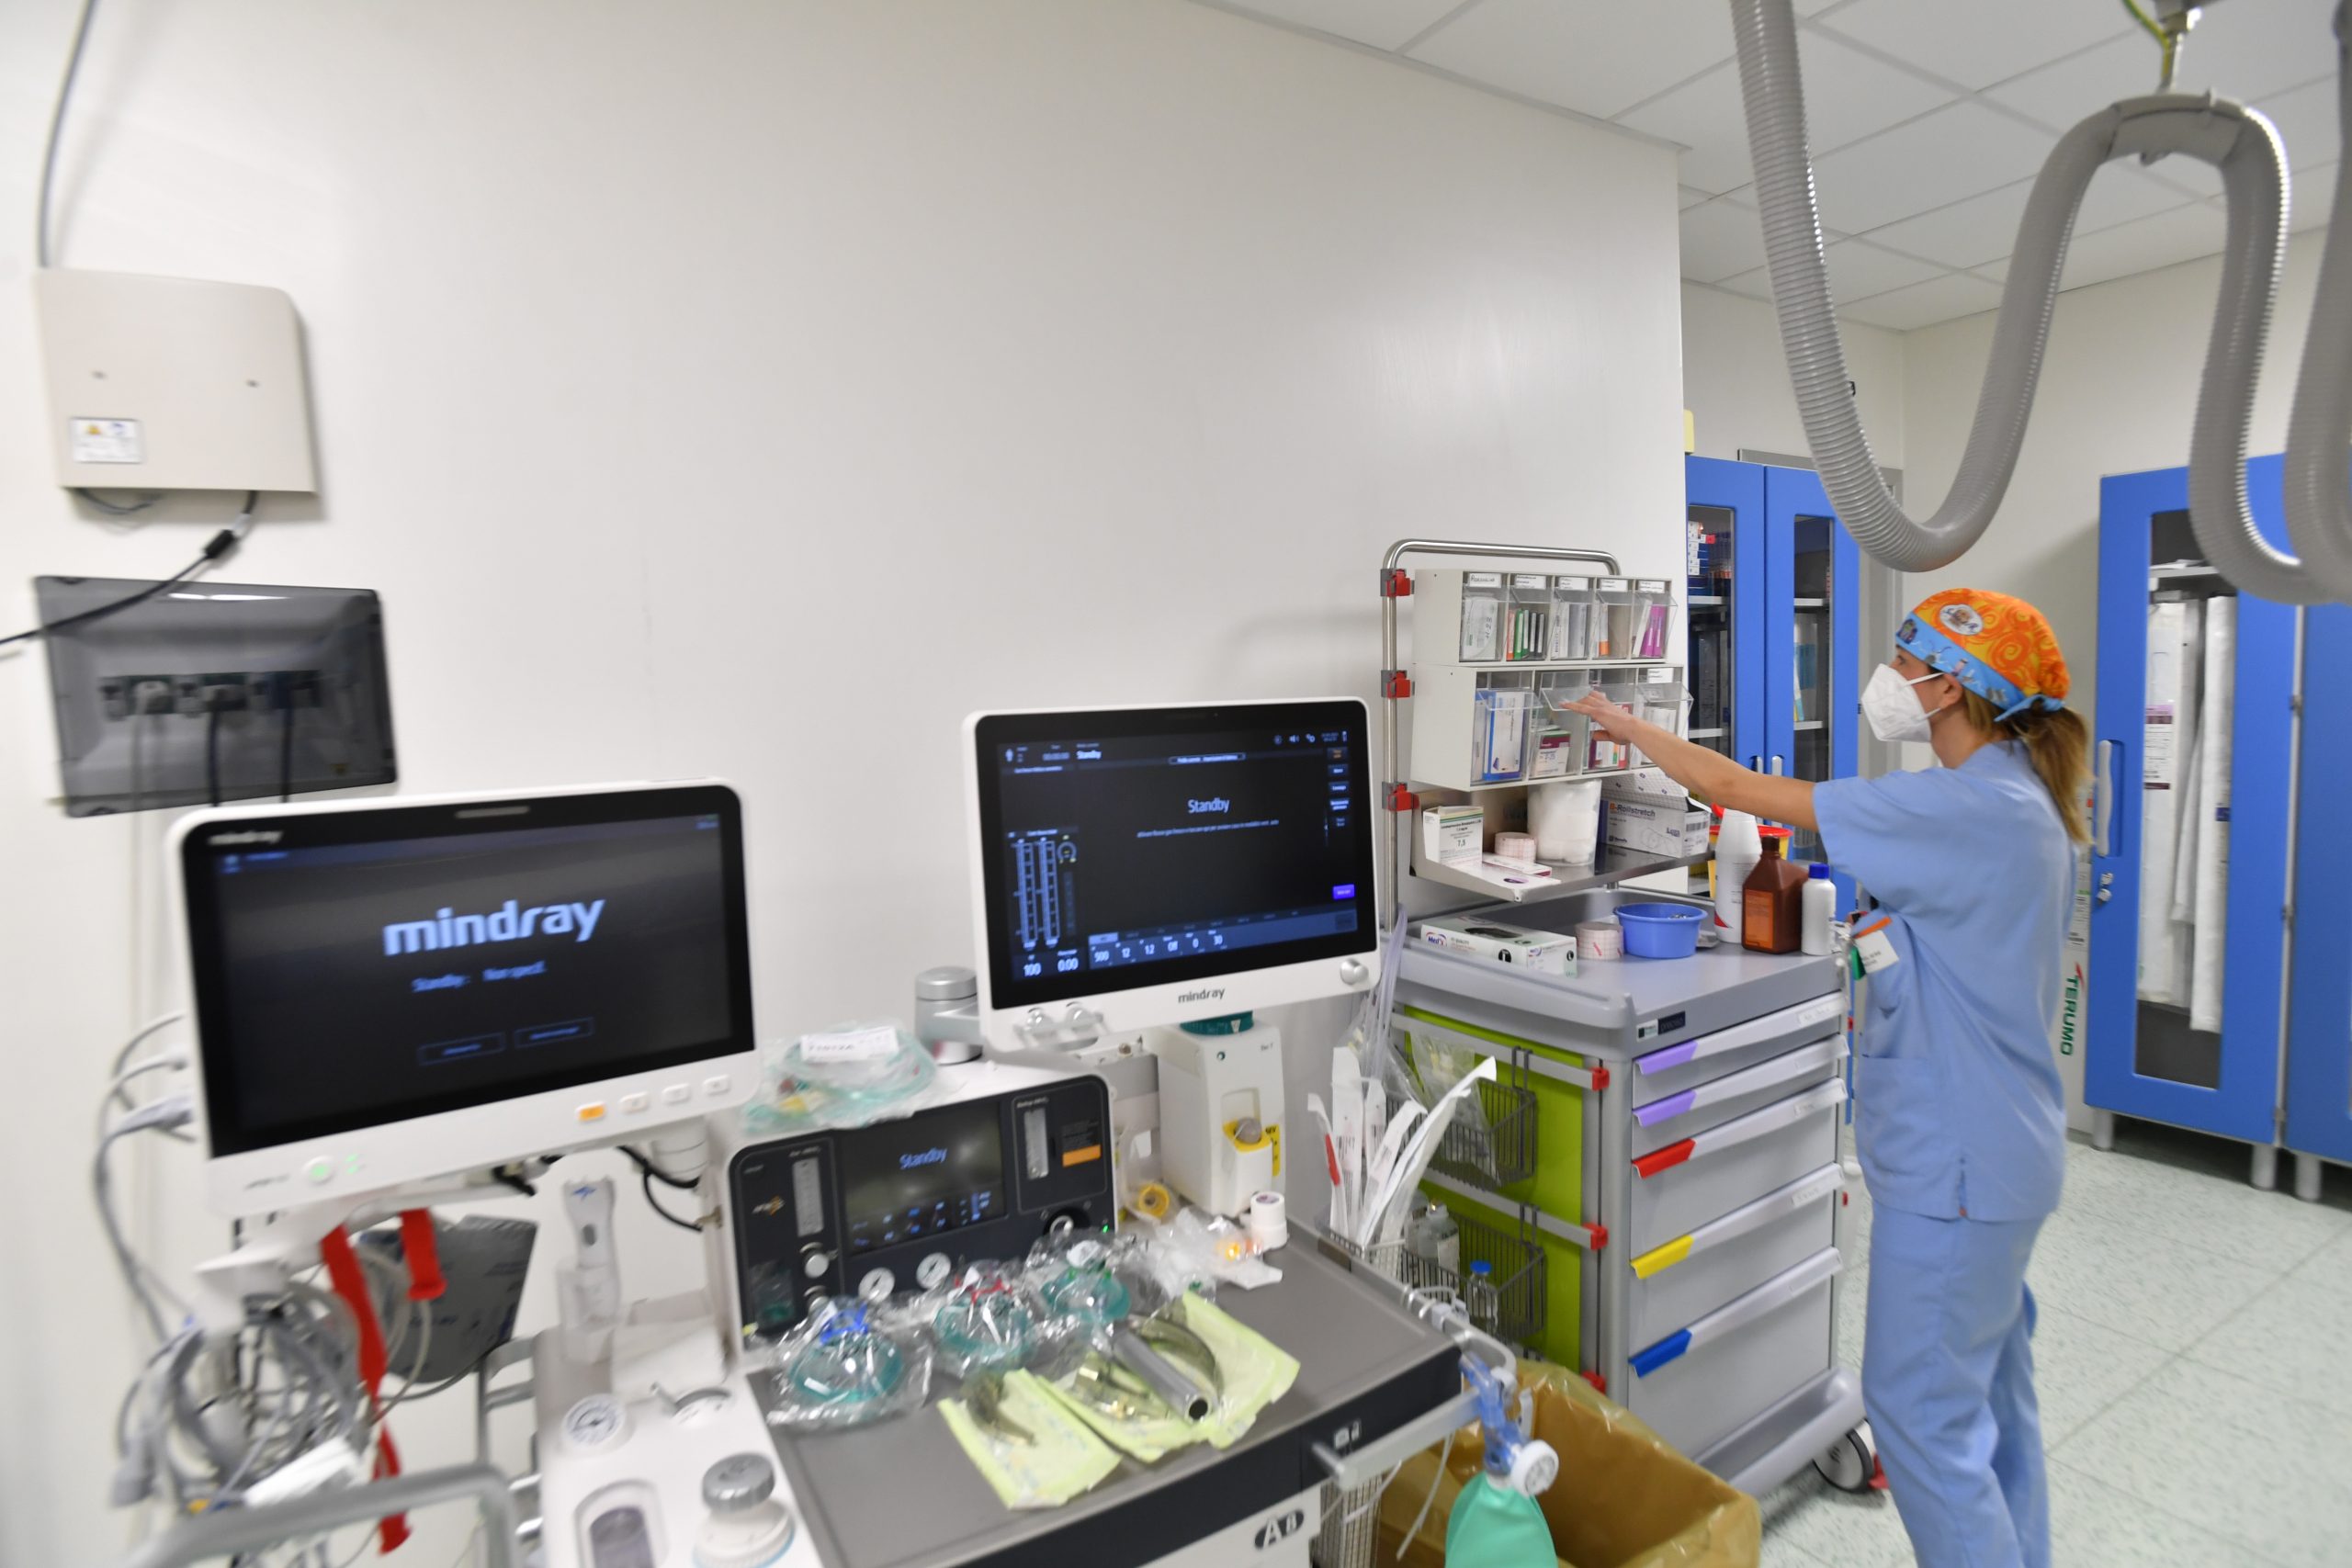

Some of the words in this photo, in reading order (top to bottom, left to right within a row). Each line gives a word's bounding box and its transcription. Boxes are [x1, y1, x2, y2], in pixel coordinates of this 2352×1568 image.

[1188, 797, 1230, 813] Standby
[383, 899, 605, 956] mindray
[1178, 988, 1226, 1004] mindray
[2060, 975, 2079, 1056] TERUMO
[899, 1147, 948, 1170] Standby
